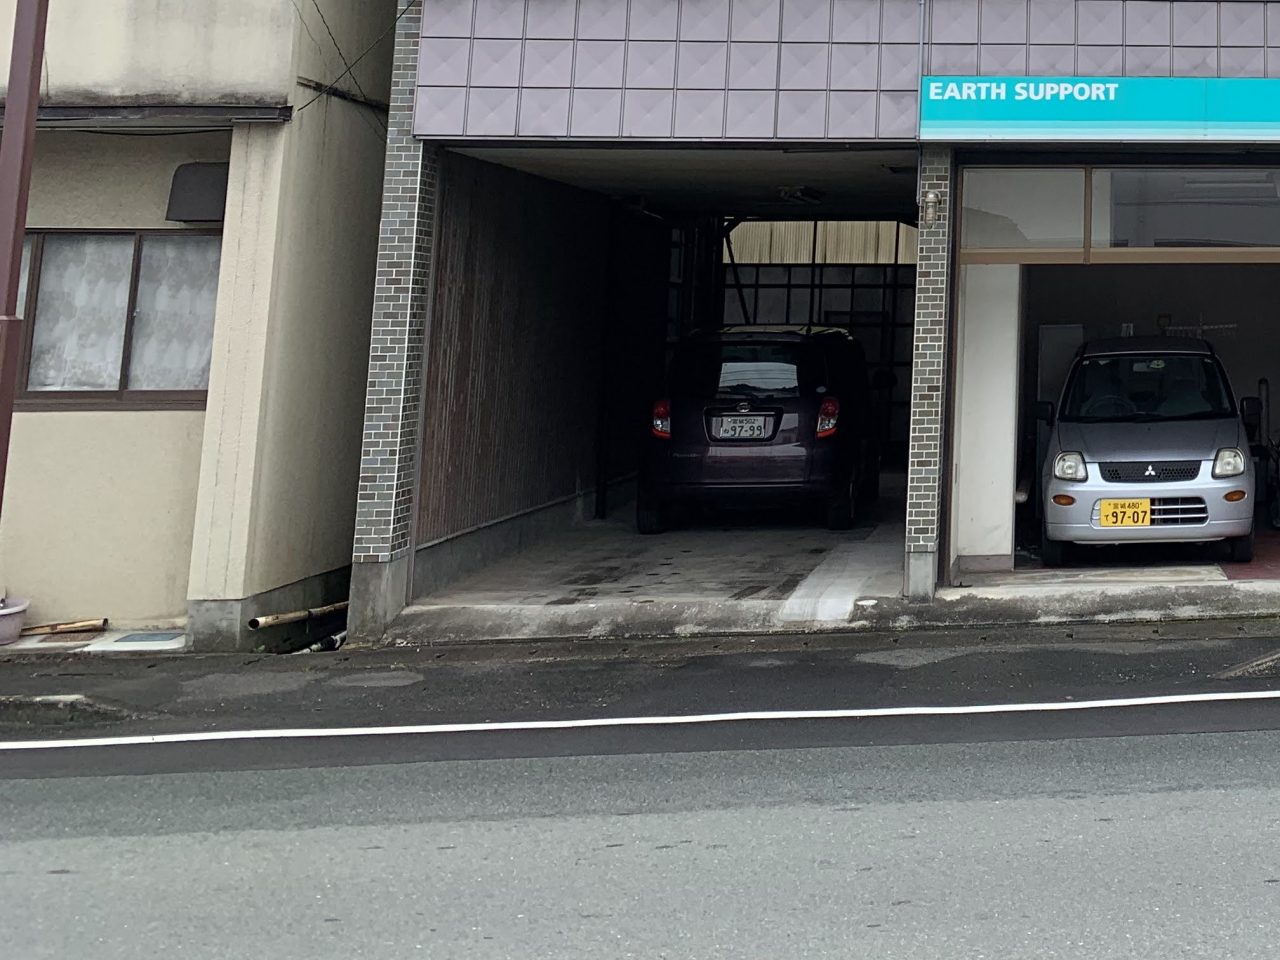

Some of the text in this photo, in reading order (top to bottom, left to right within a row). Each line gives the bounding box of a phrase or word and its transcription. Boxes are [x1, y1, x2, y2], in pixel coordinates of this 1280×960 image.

[929, 82, 1119, 101] EARTH SUPPORT
[730, 425, 763, 437] 97-99
[1111, 510, 1148, 524] 97-07
